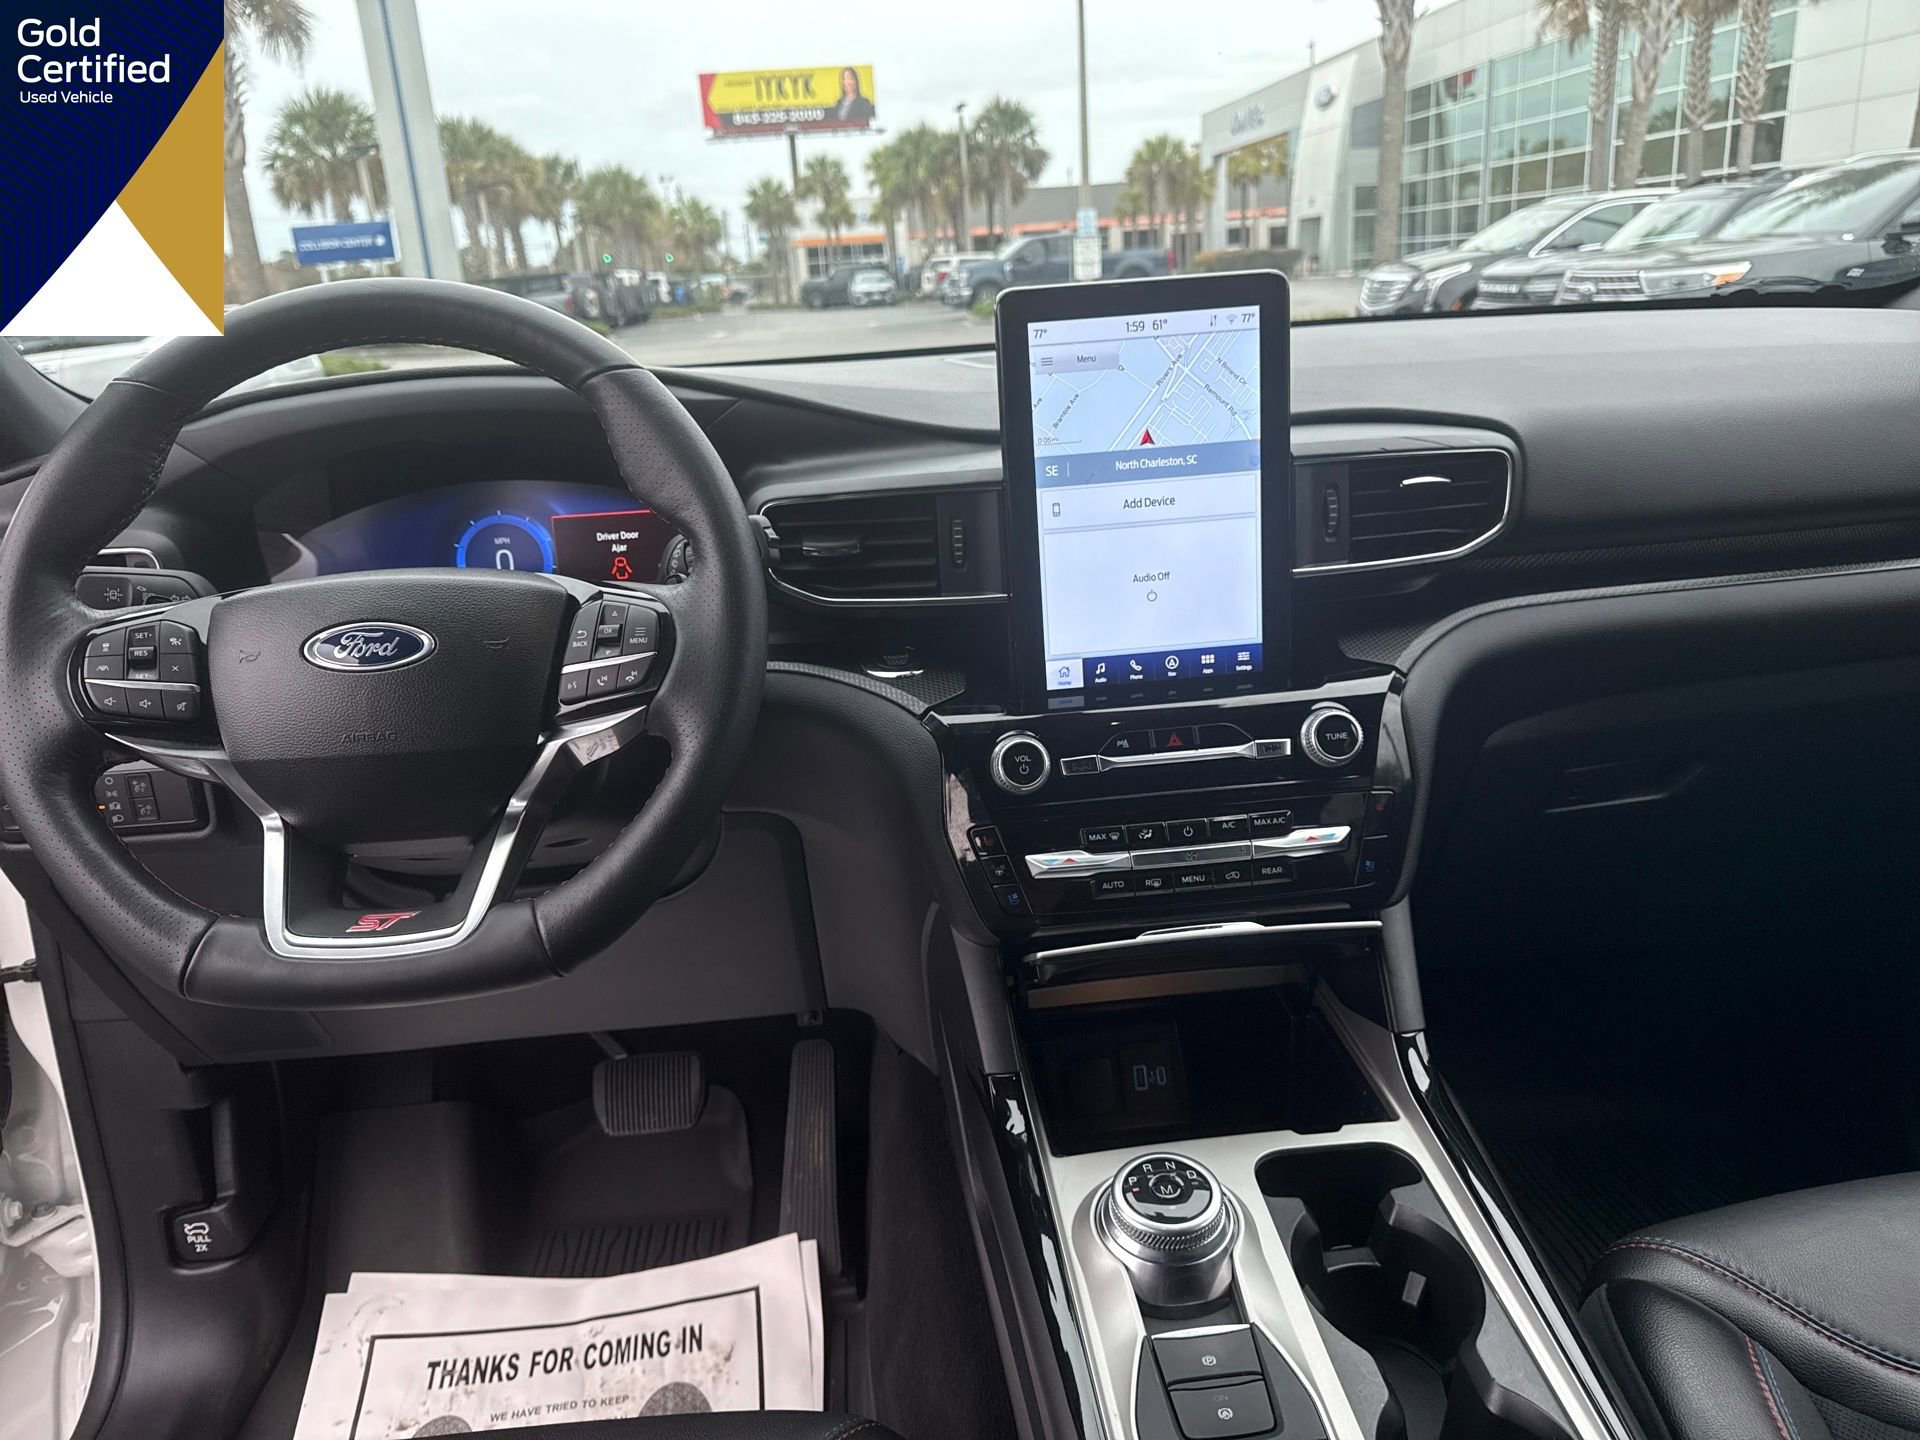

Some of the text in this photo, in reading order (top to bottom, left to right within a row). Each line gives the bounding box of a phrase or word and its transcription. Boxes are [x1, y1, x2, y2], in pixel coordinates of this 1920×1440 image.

[1241, 313, 1256, 323] 77°
[1125, 321, 1145, 333] 1:59
[1152, 319, 1168, 331] 61°
[1033, 329, 1048, 339] 77°
[1076, 355, 1097, 364] Menu
[1156, 353, 1183, 386] Rivers Ave
[1069, 393, 1080, 406] Ave
[1203, 383, 1238, 417] Remount Rd
[1115, 454, 1198, 471] North Charleston, SC
[1045, 465, 1059, 477] SE
[1123, 495, 1176, 510] Add Device
[494, 537, 511, 545] MPH
[596, 530, 640, 542] Driver Door
[611, 543, 628, 553] Ajar
[1133, 571, 1170, 584] Audio Off
[333, 631, 400, 659] Ford
[572, 640, 588, 648] BACK
[1235, 664, 1253, 672] Settings
[1094, 676, 1108, 684] Audio
[1129, 673, 1144, 681] Phone
[341, 731, 398, 745] AIRBAG
[1325, 732, 1348, 742] TUNE
[1014, 754, 1032, 763] VOL
[1221, 821, 1236, 830] A/C
[1253, 816, 1287, 827] MAX A/C
[1088, 832, 1107, 842] MAX
[1261, 866, 1283, 875] REAR
[1181, 874, 1206, 884] MENU
[1102, 880, 1125, 890] AUTO
[345, 910, 422, 933] ST
[1142, 1163, 1153, 1173] R
[1165, 1160, 1176, 1170] N
[1186, 1170, 1197, 1179] D
[1128, 1176, 1137, 1186] P
[1160, 1184, 1174, 1195] M
[186, 1235, 212, 1244] PULL
[195, 1243, 208, 1252] 2X
[427, 1322, 704, 1391] THANKS FOR COMING IN
[490, 1394, 630, 1423] WE HAVE TRIED TO KEEP
